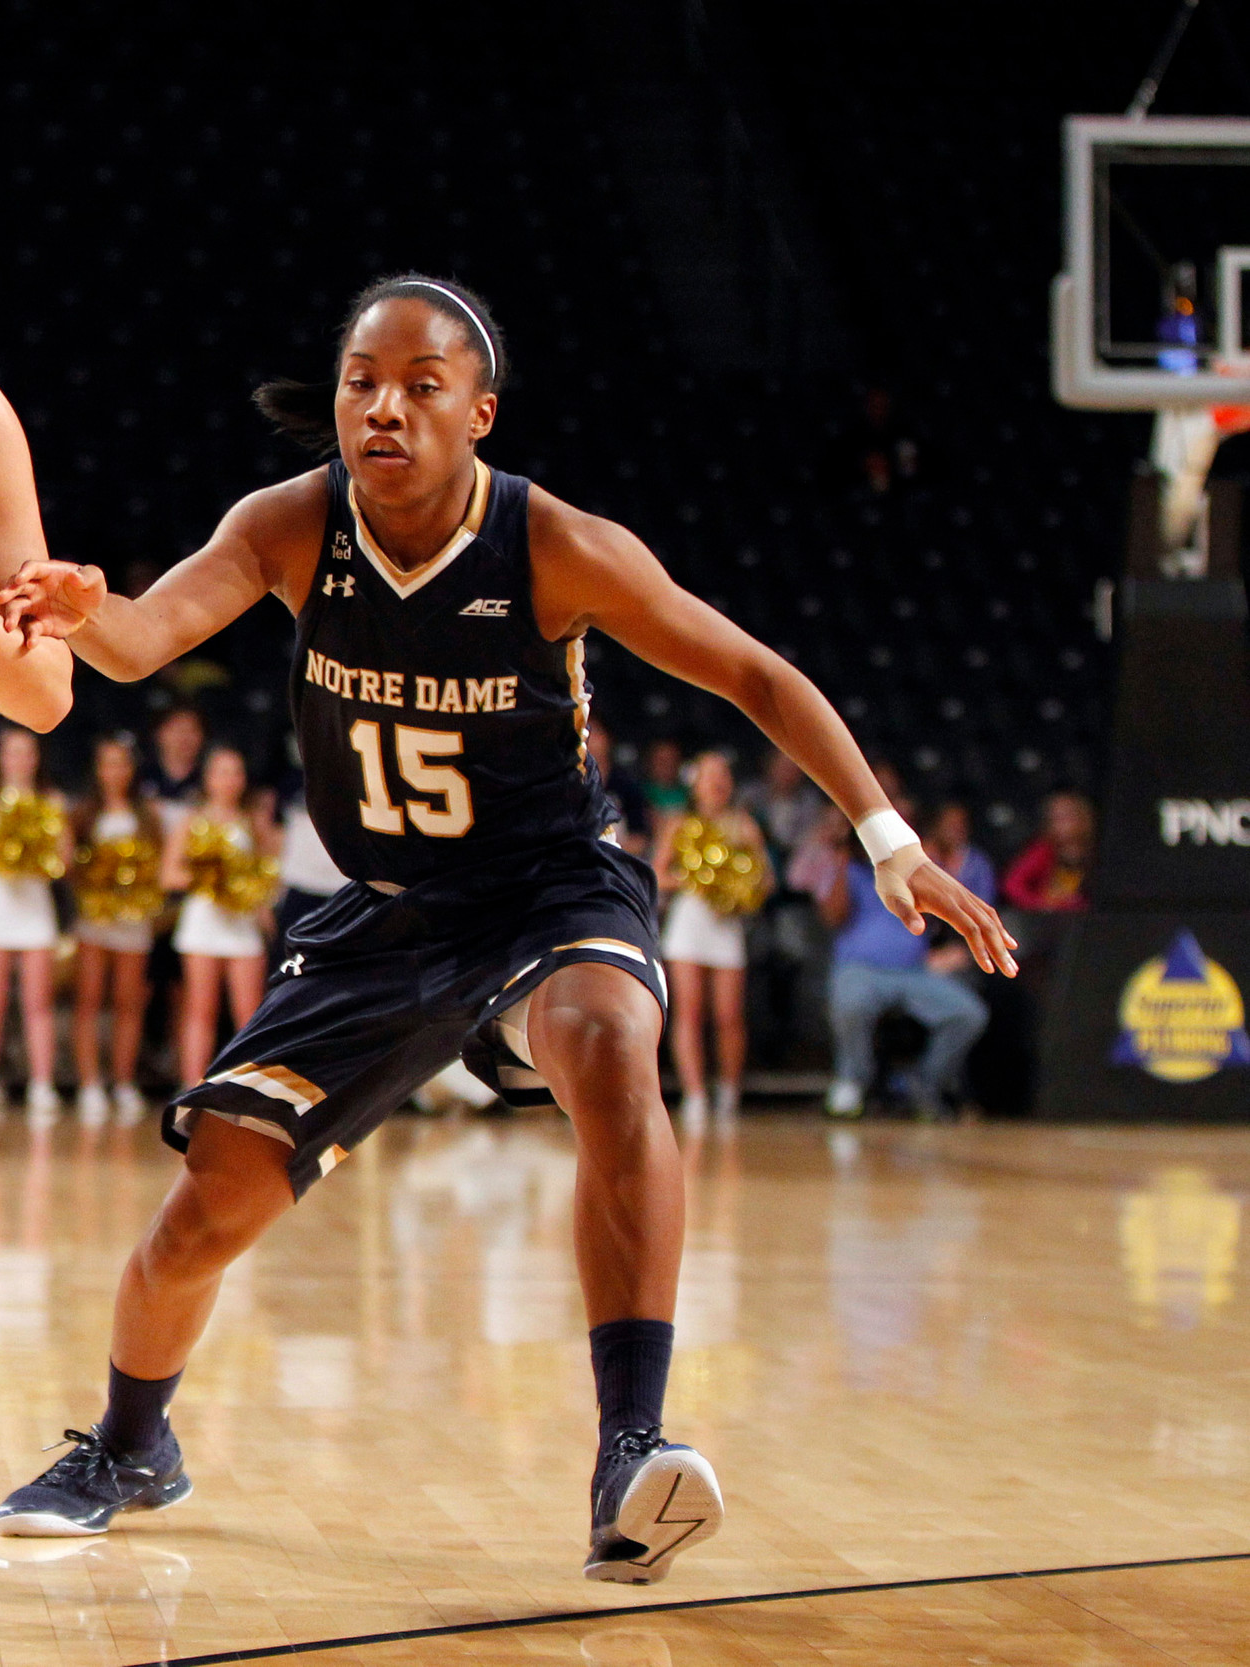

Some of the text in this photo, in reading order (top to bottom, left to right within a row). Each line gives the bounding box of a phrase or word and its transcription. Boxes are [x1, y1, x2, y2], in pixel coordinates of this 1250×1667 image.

[330, 543, 352, 560] Ted
[461, 598, 512, 614] ACC
[305, 648, 519, 714] NOTRE DAME
[350, 718, 475, 839] 15
